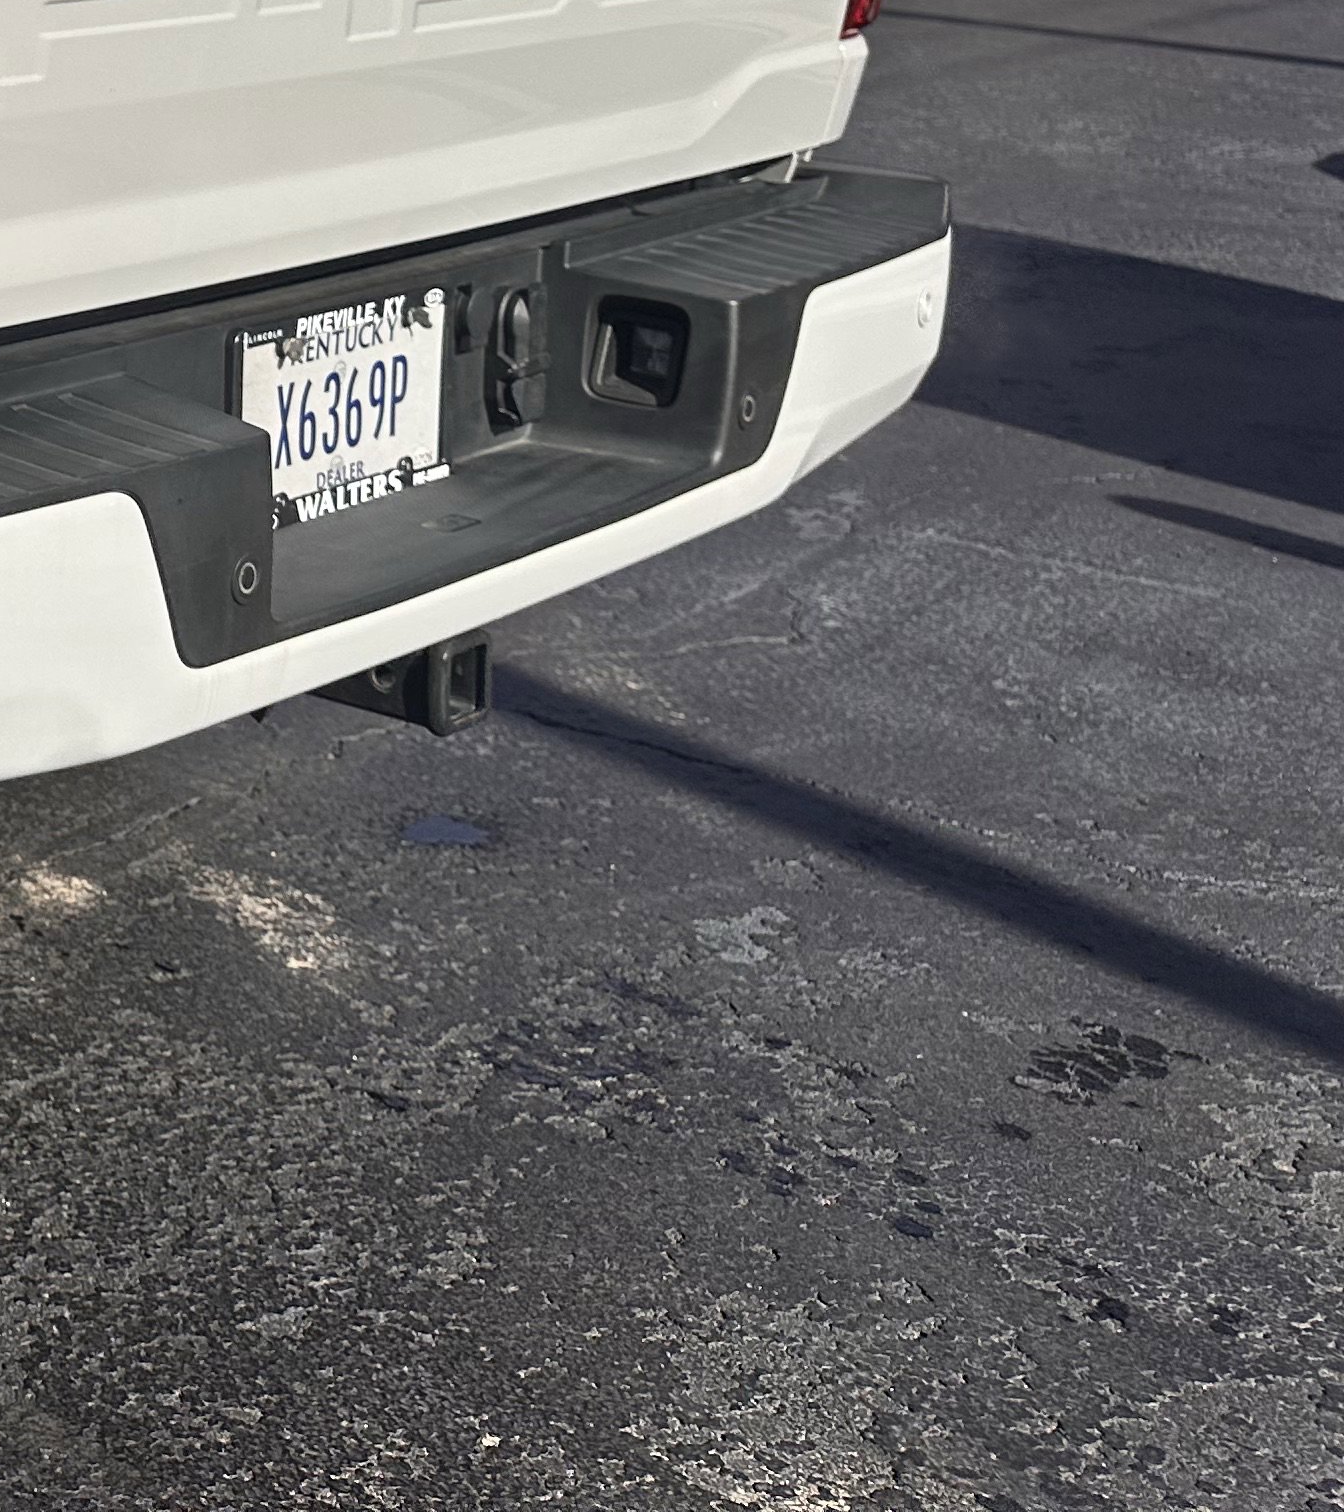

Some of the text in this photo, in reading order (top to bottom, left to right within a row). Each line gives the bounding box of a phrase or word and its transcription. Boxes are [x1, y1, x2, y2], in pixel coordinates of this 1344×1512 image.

[383, 294, 406, 320] KY
[299, 314, 399, 363] ENTUCKY
[274, 353, 408, 470] X6369P
[295, 469, 403, 523] WALTERS
[316, 459, 366, 491] DEALER
